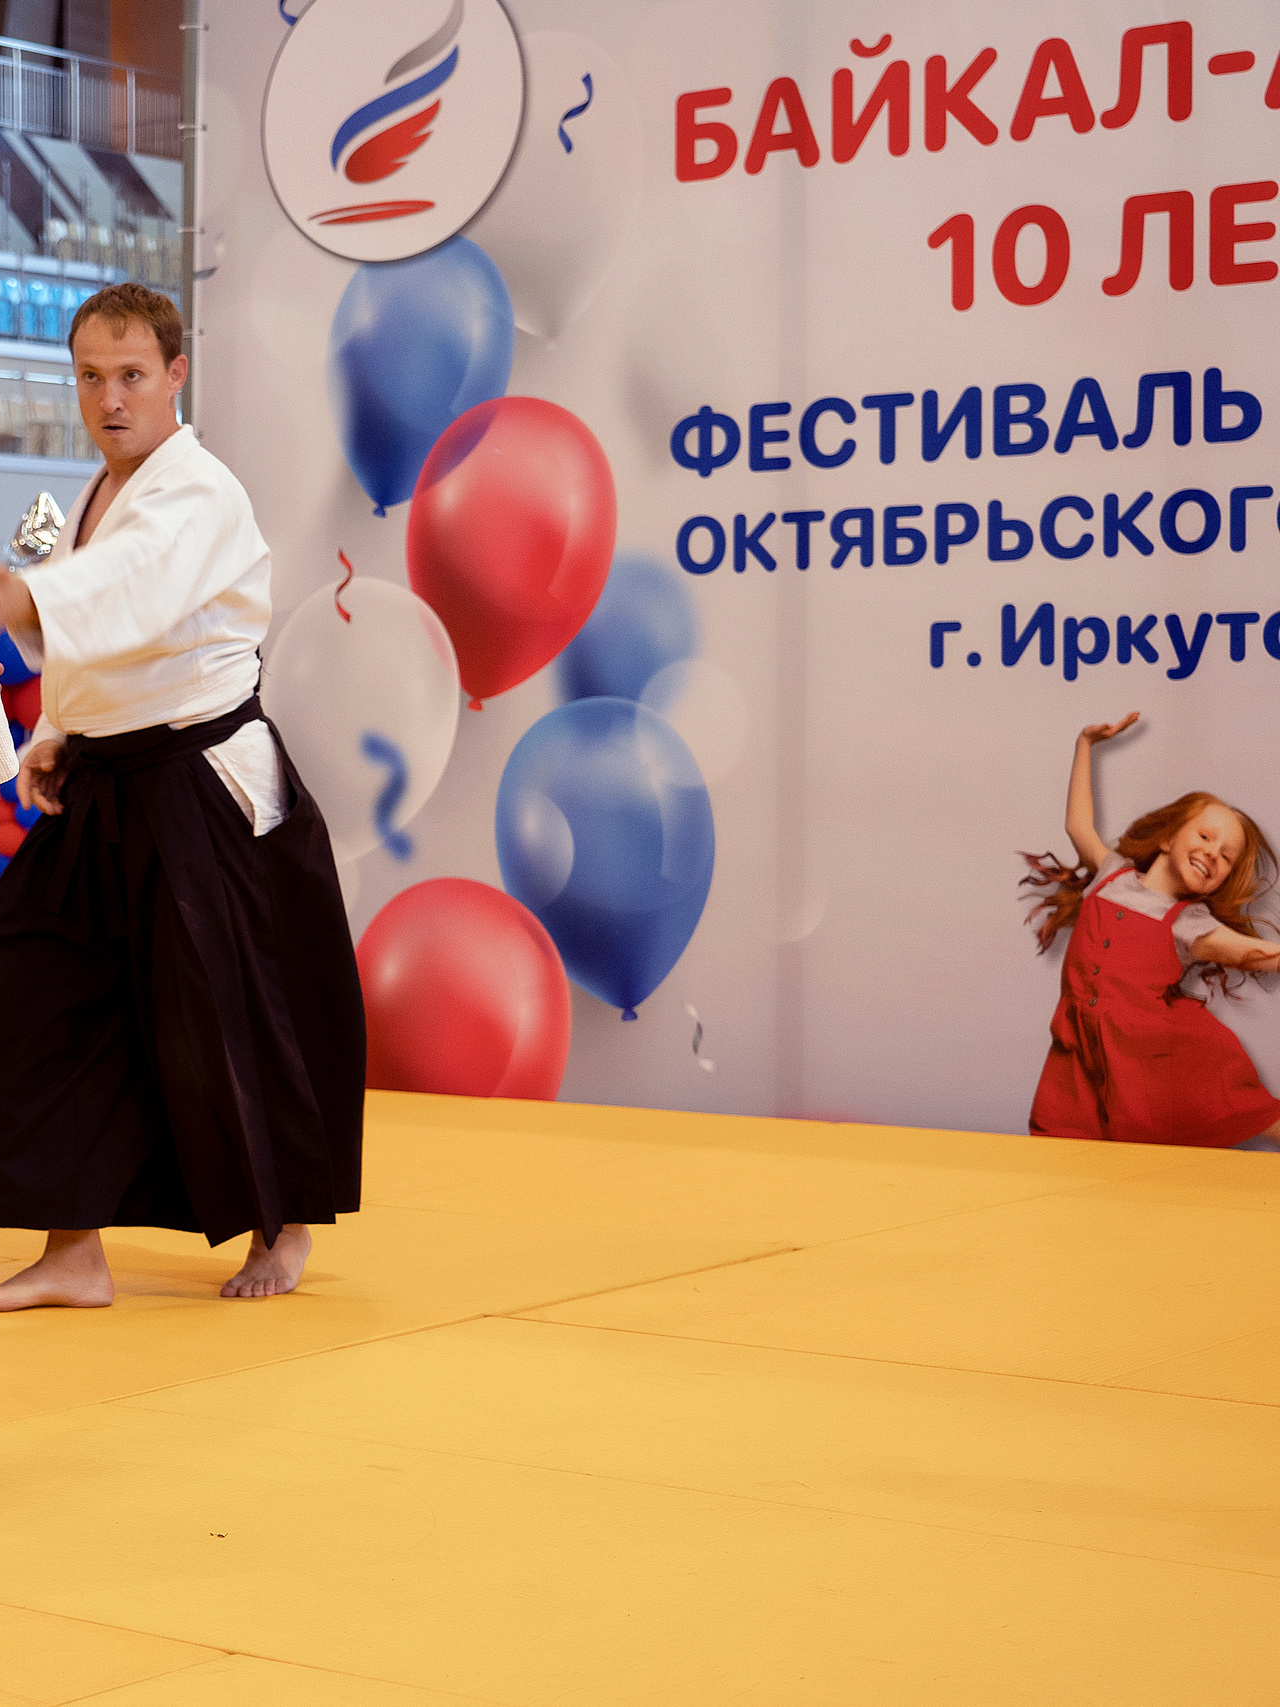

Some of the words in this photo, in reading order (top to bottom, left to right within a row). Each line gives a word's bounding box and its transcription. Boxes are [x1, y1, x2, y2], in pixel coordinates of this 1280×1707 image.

[674, 20, 1280, 183] БАЙКАЛ-
[927, 204, 1071, 312] 10
[1101, 180, 1279, 298] ЛЕ
[670, 367, 1262, 478] ФЕСТИВАЛЬ
[676, 485, 1280, 575] ОКТЯБРЬСКОГ
[930, 621, 981, 669] г.
